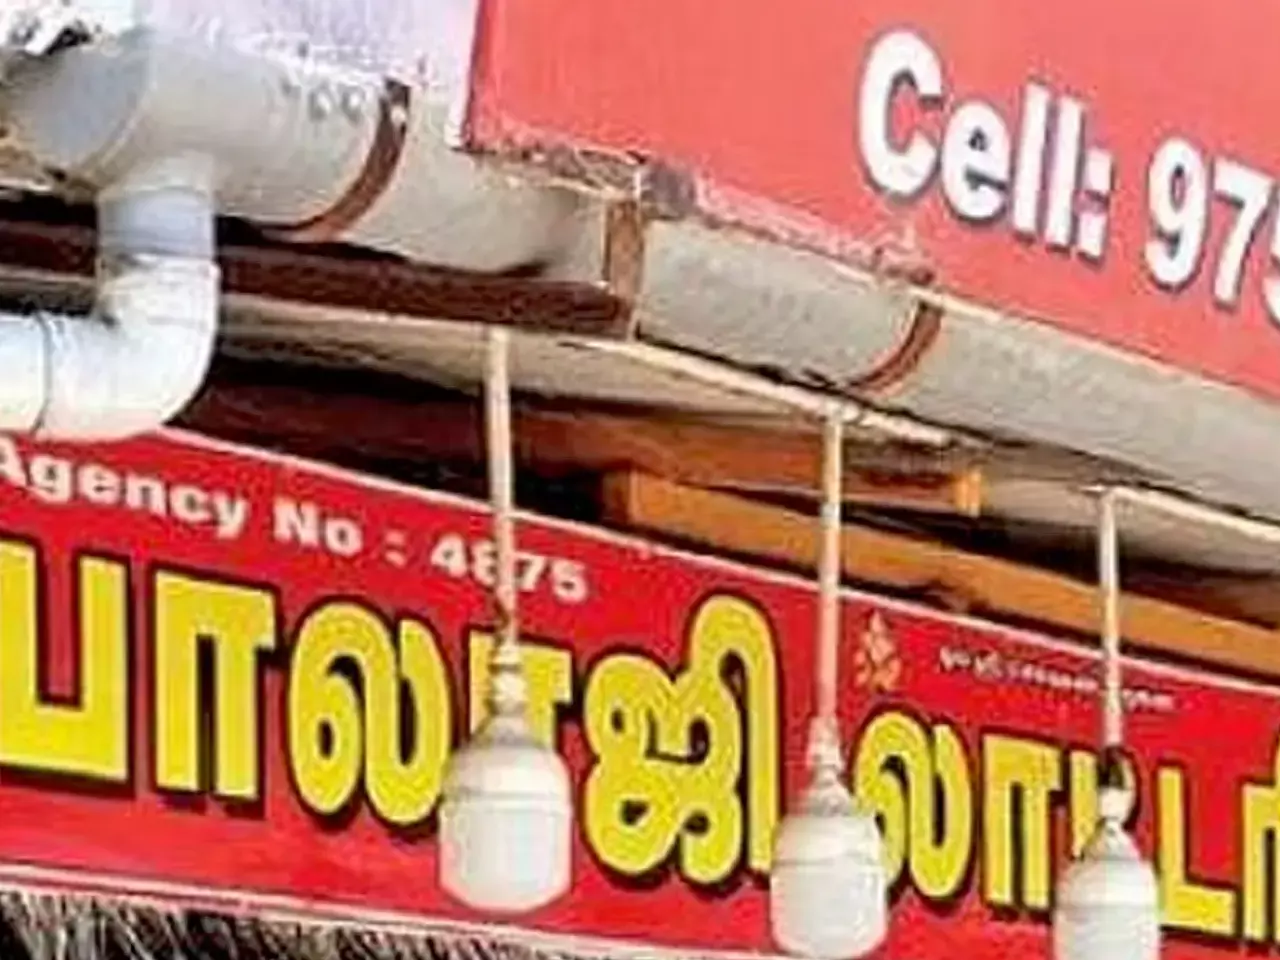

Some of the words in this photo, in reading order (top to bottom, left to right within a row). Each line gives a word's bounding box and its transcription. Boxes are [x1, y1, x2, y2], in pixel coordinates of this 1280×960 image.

[858, 30, 1114, 258] Cell:
[0, 446, 247, 539] Agency
[273, 502, 363, 556] No
